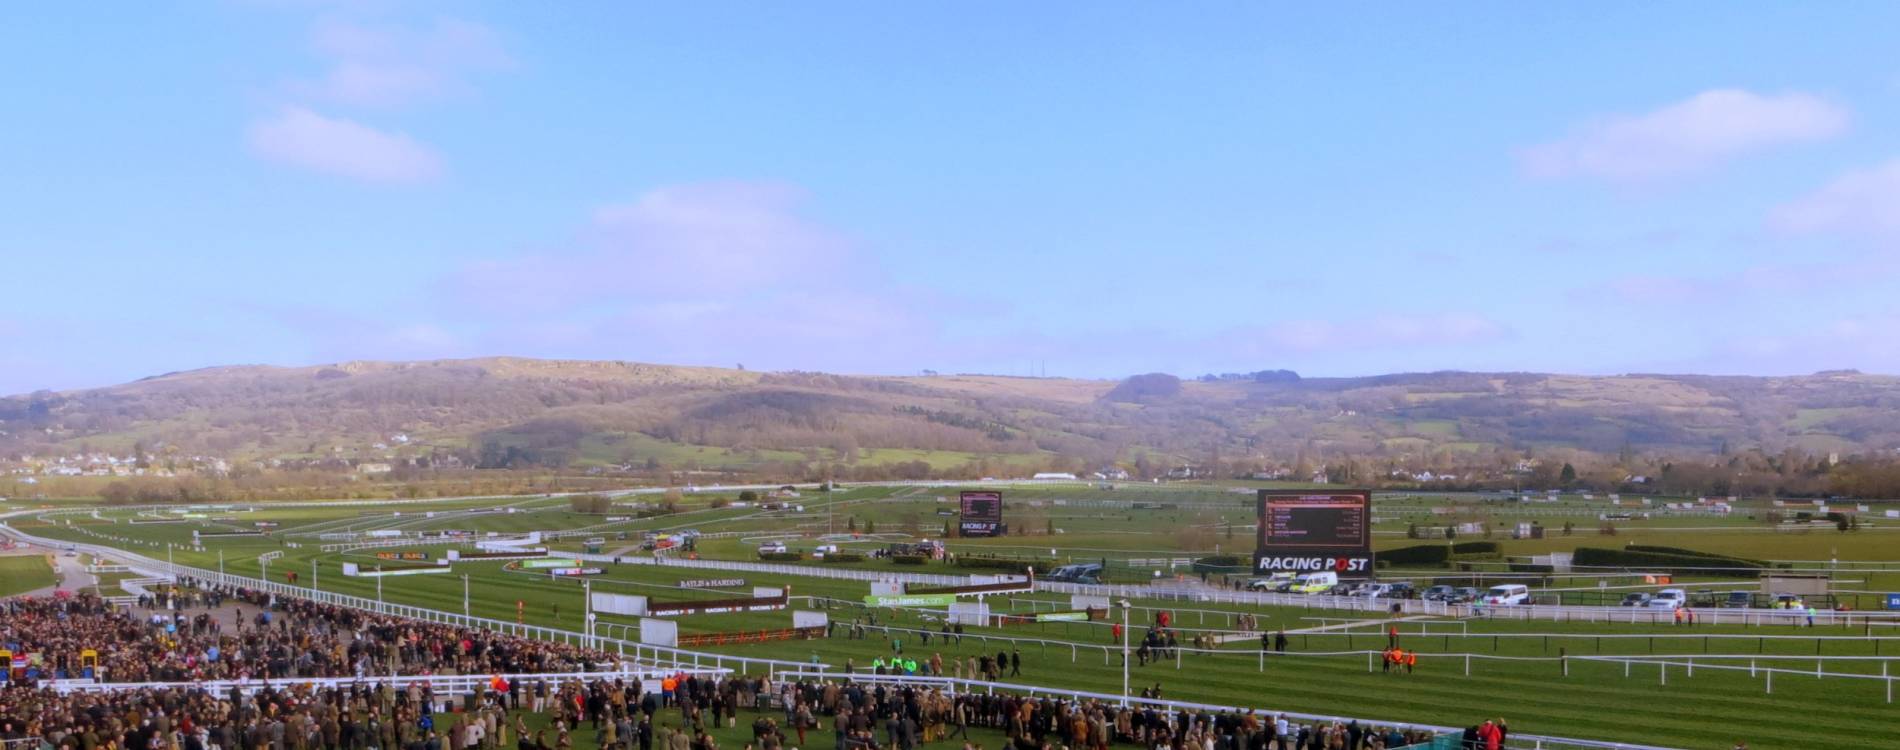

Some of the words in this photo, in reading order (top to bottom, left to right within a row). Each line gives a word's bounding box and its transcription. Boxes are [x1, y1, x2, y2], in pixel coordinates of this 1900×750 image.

[1260, 557, 1321, 570] RACING
[1325, 557, 1369, 571] POST
[711, 578, 745, 587] HARDING
[878, 597, 944, 606] StanJames.com
